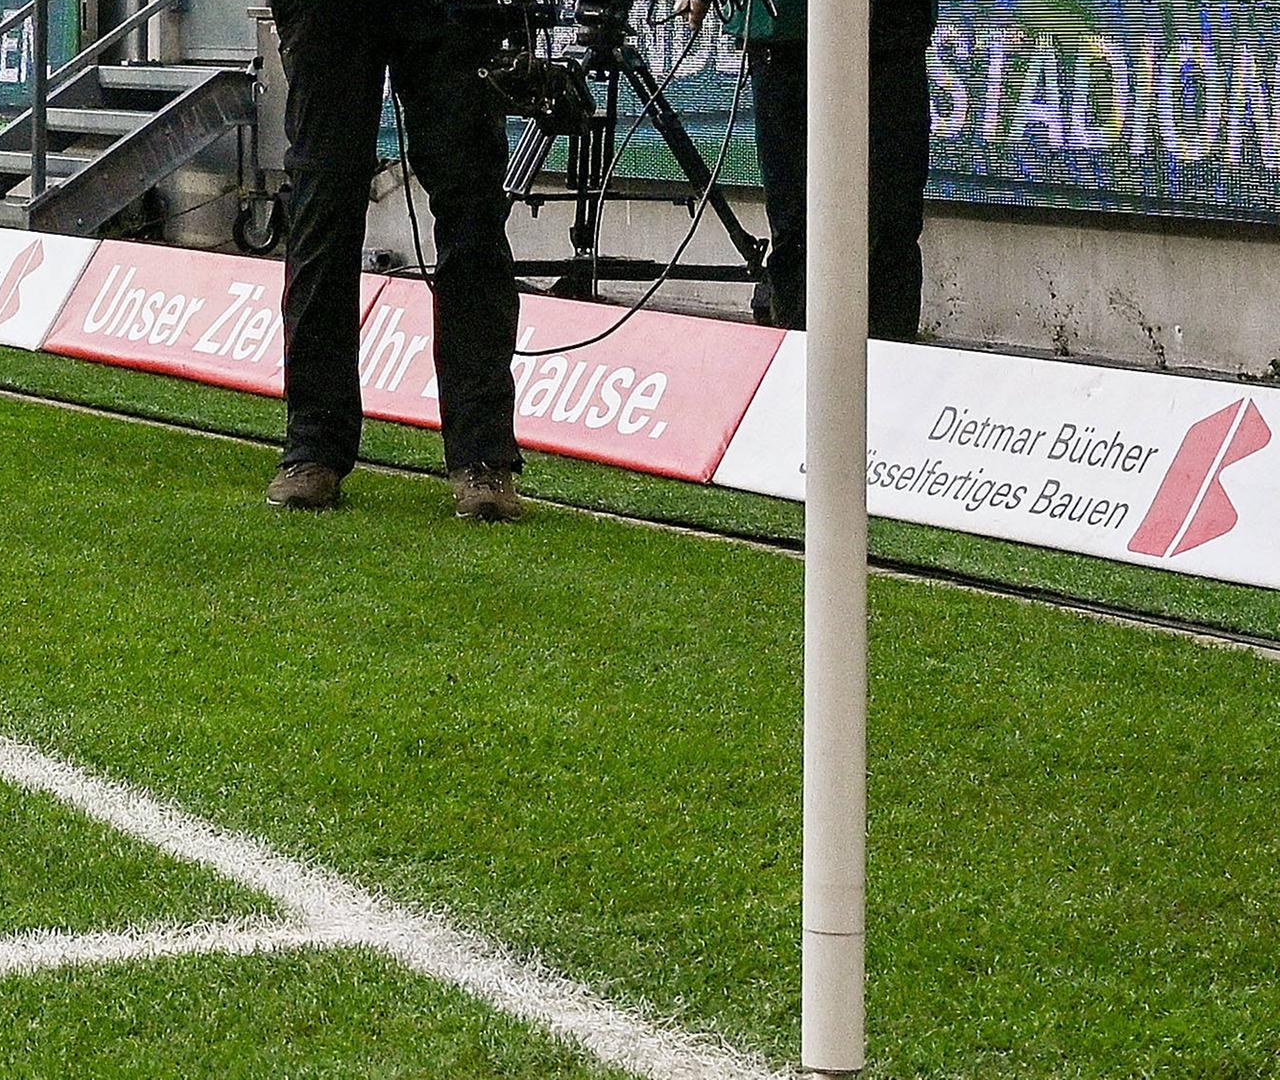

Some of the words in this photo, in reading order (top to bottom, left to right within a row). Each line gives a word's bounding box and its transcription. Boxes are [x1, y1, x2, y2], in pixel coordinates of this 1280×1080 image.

[82, 264, 206, 348] Unser
[357, 304, 431, 392] Ihr
[927, 405, 1046, 456] Dietmar
[1047, 422, 1160, 474] Bücher
[1028, 478, 1130, 530] Bauen
